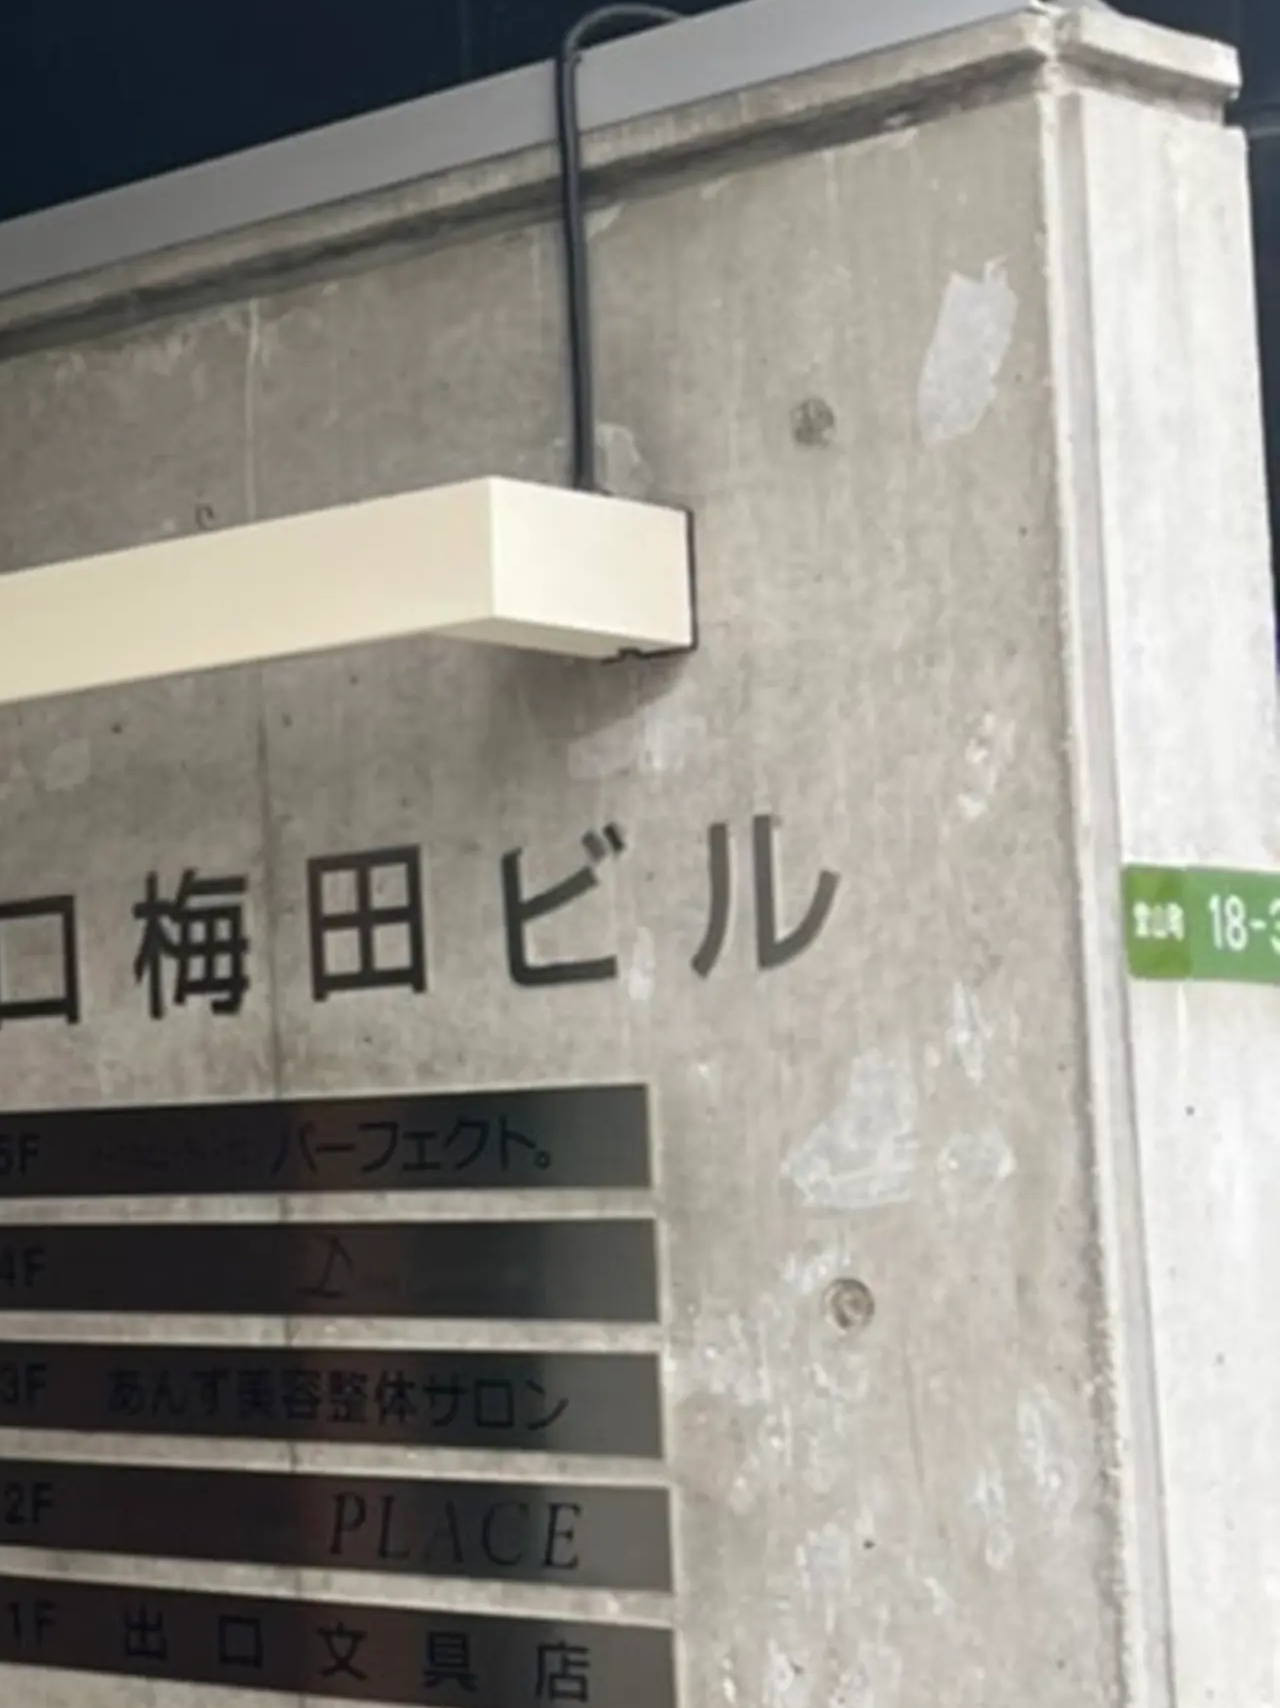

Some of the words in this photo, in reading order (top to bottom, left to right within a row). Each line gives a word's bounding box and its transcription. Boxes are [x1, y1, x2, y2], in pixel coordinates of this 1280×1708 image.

[107, 1366, 569, 1431] あんず美容整体サロン
[3, 1481, 54, 1527] 2F
[329, 1491, 585, 1571] PLACE
[7, 1599, 57, 1650] 1F
[123, 1602, 591, 1702] 出口文具店
